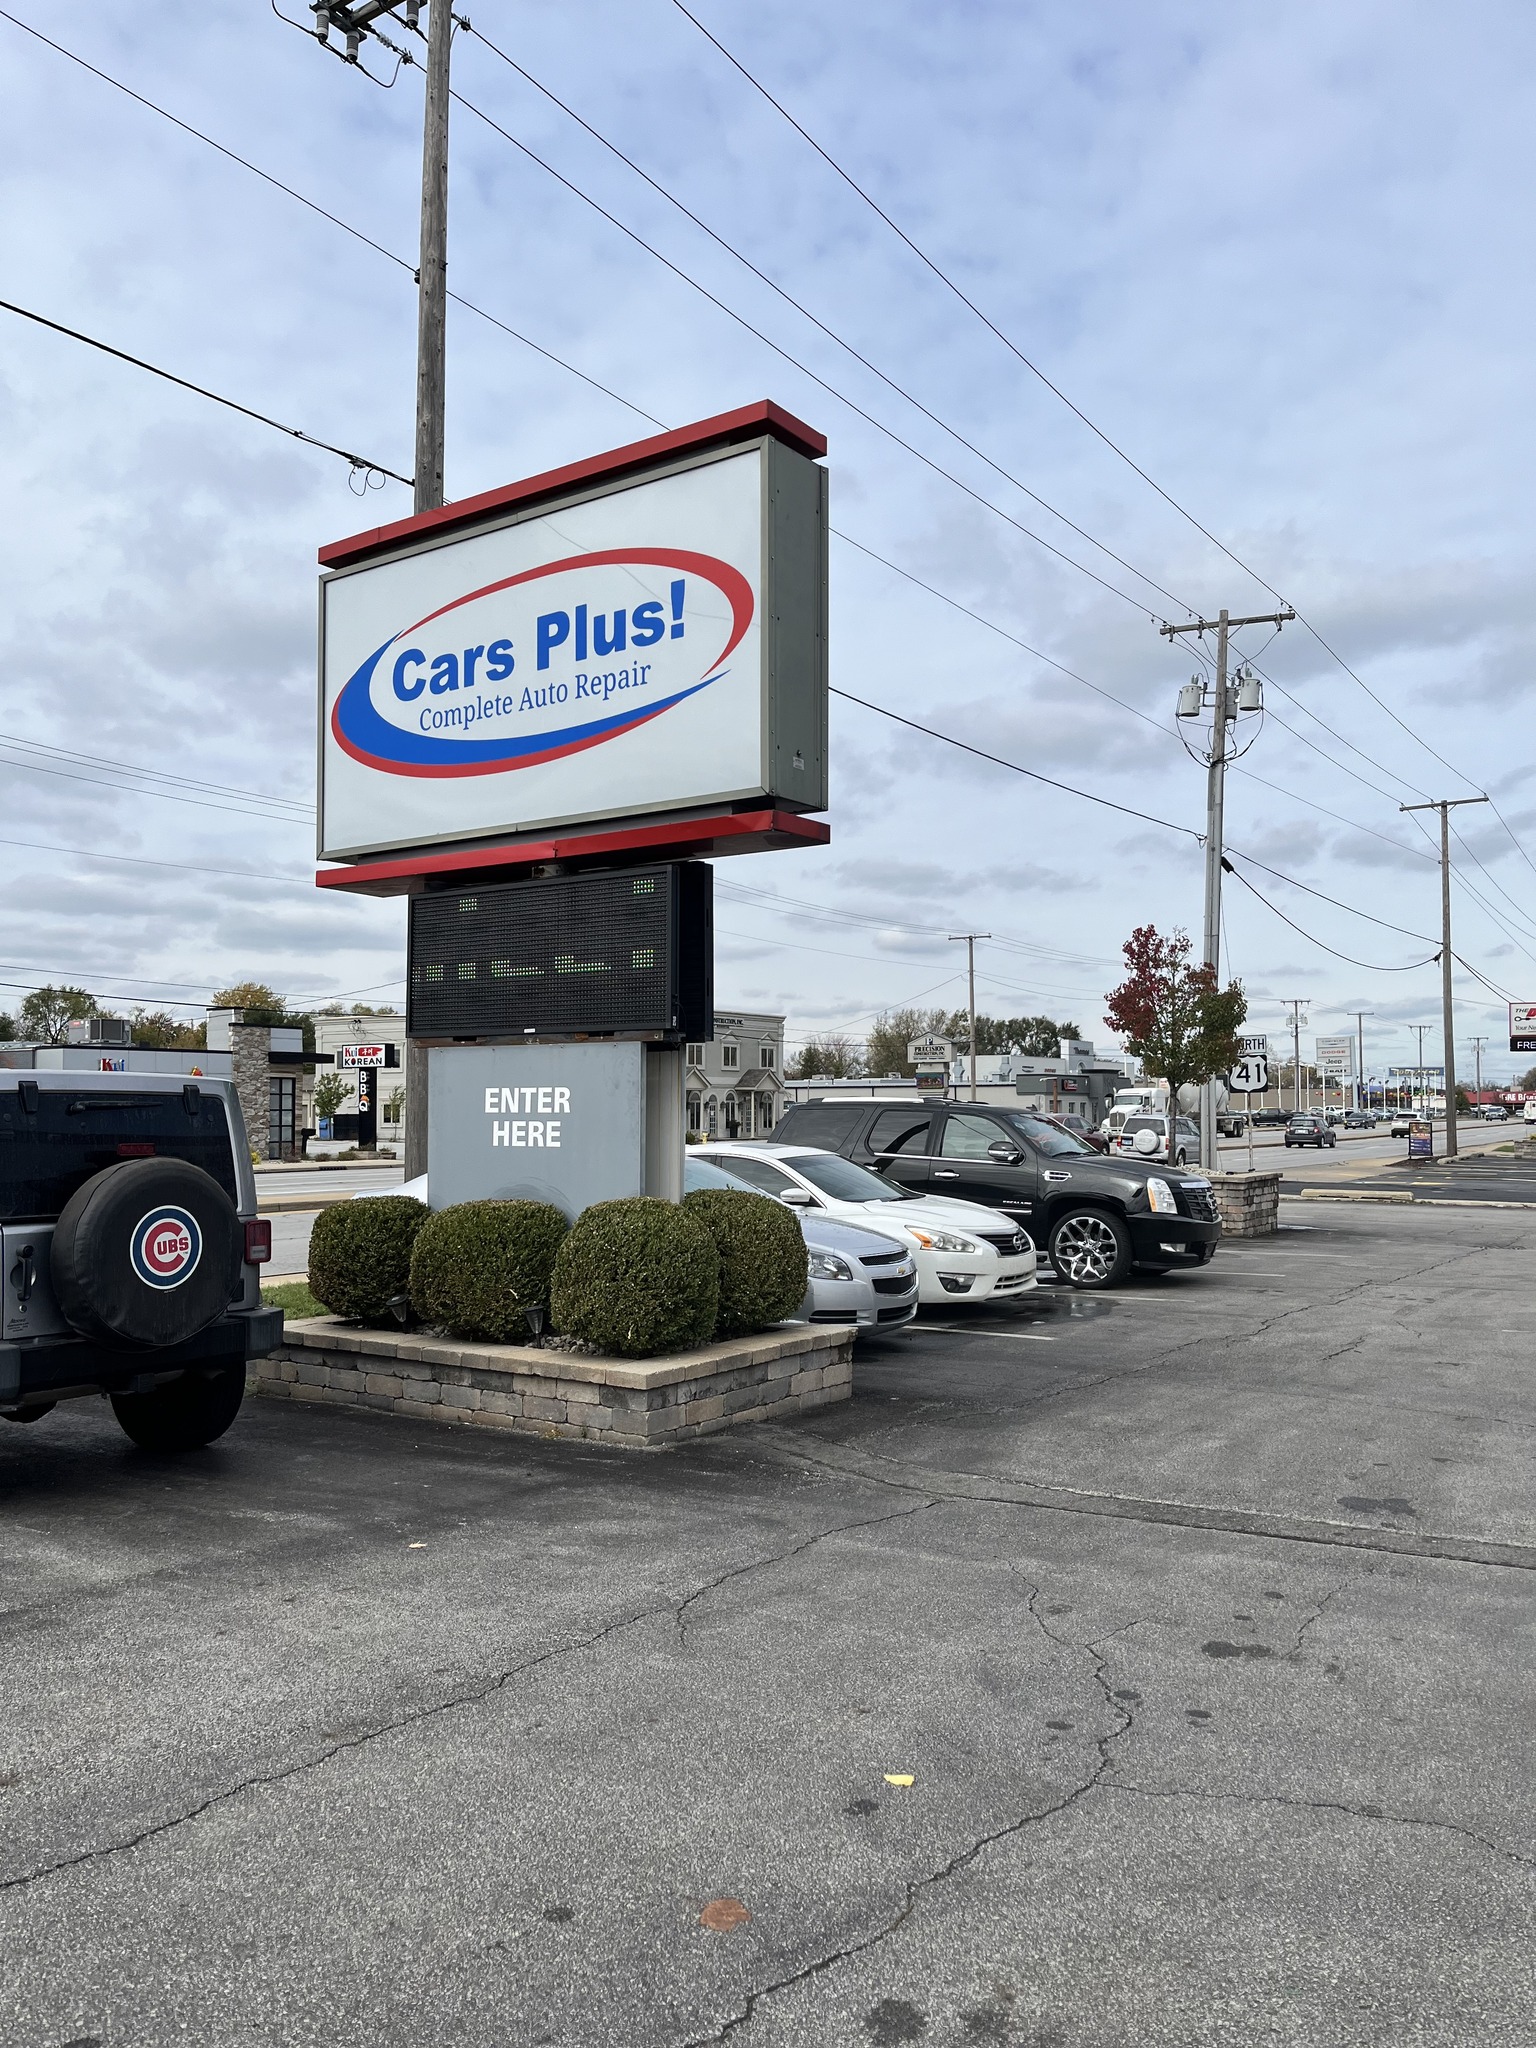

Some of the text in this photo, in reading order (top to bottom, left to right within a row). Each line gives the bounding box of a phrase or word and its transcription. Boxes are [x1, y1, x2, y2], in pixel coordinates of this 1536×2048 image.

[392, 579, 685, 702] Cars Plus!
[419, 660, 652, 731] Complete Auto Repair
[1237, 1038, 1265, 1050] RTH
[344, 1057, 382, 1066] KOREAN
[1236, 1063, 1261, 1083] 41
[484, 1086, 571, 1113] ENTER
[492, 1120, 561, 1147] HERE
[145, 1221, 189, 1273] CUBS
